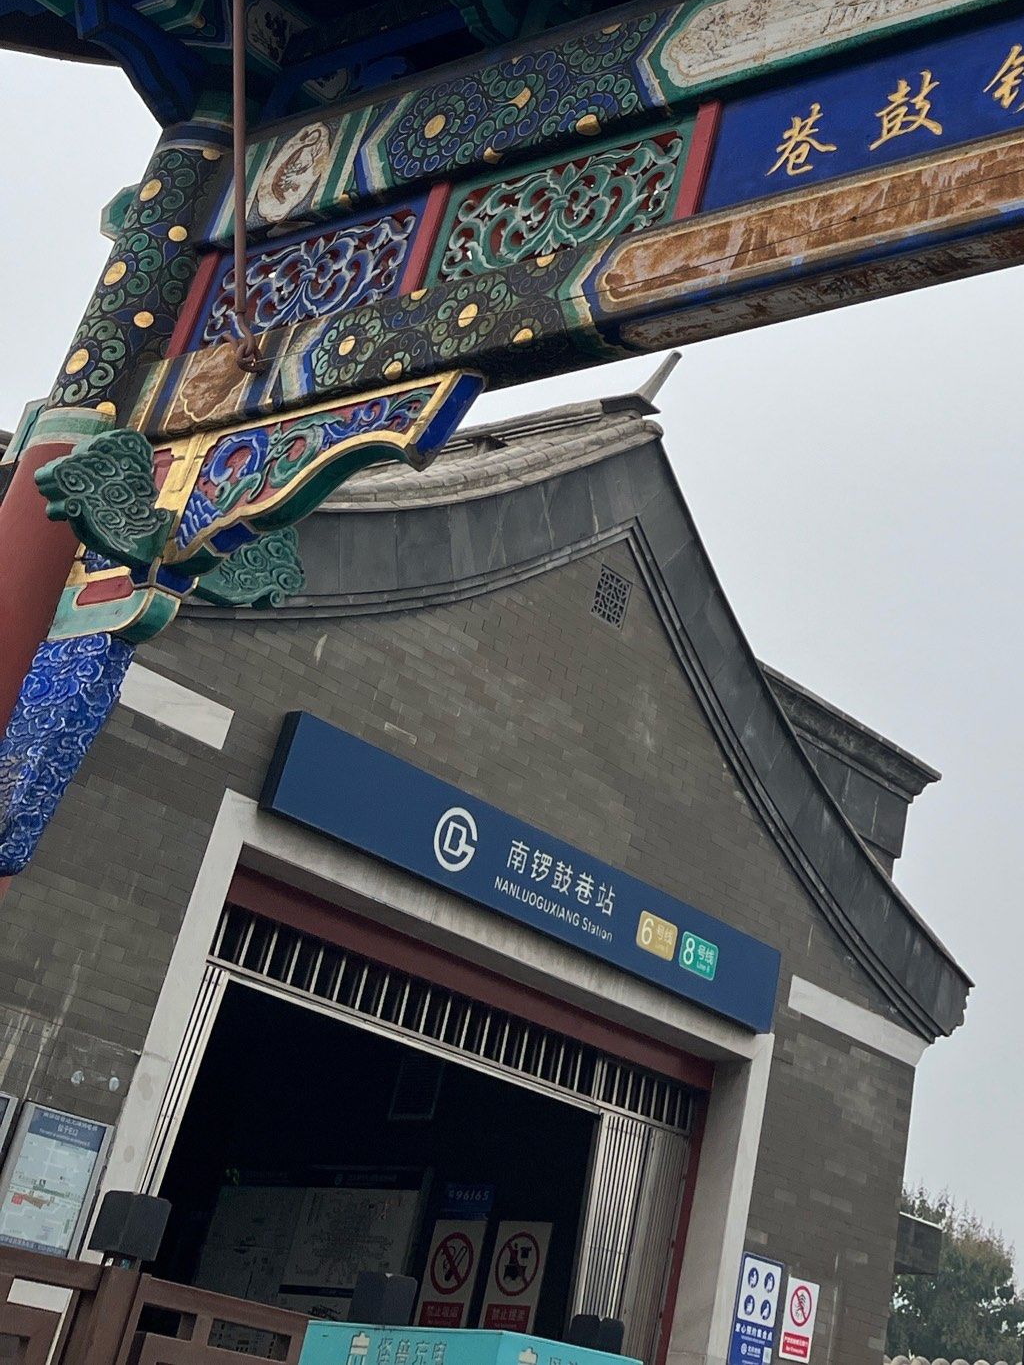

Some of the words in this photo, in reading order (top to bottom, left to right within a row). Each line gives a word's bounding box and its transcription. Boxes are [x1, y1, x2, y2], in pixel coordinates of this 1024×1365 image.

[494, 875, 580, 928] NANLUOGUXIANG
[582, 917, 613, 943] Station
[506, 838, 616, 916] 南锣鼓巷站
